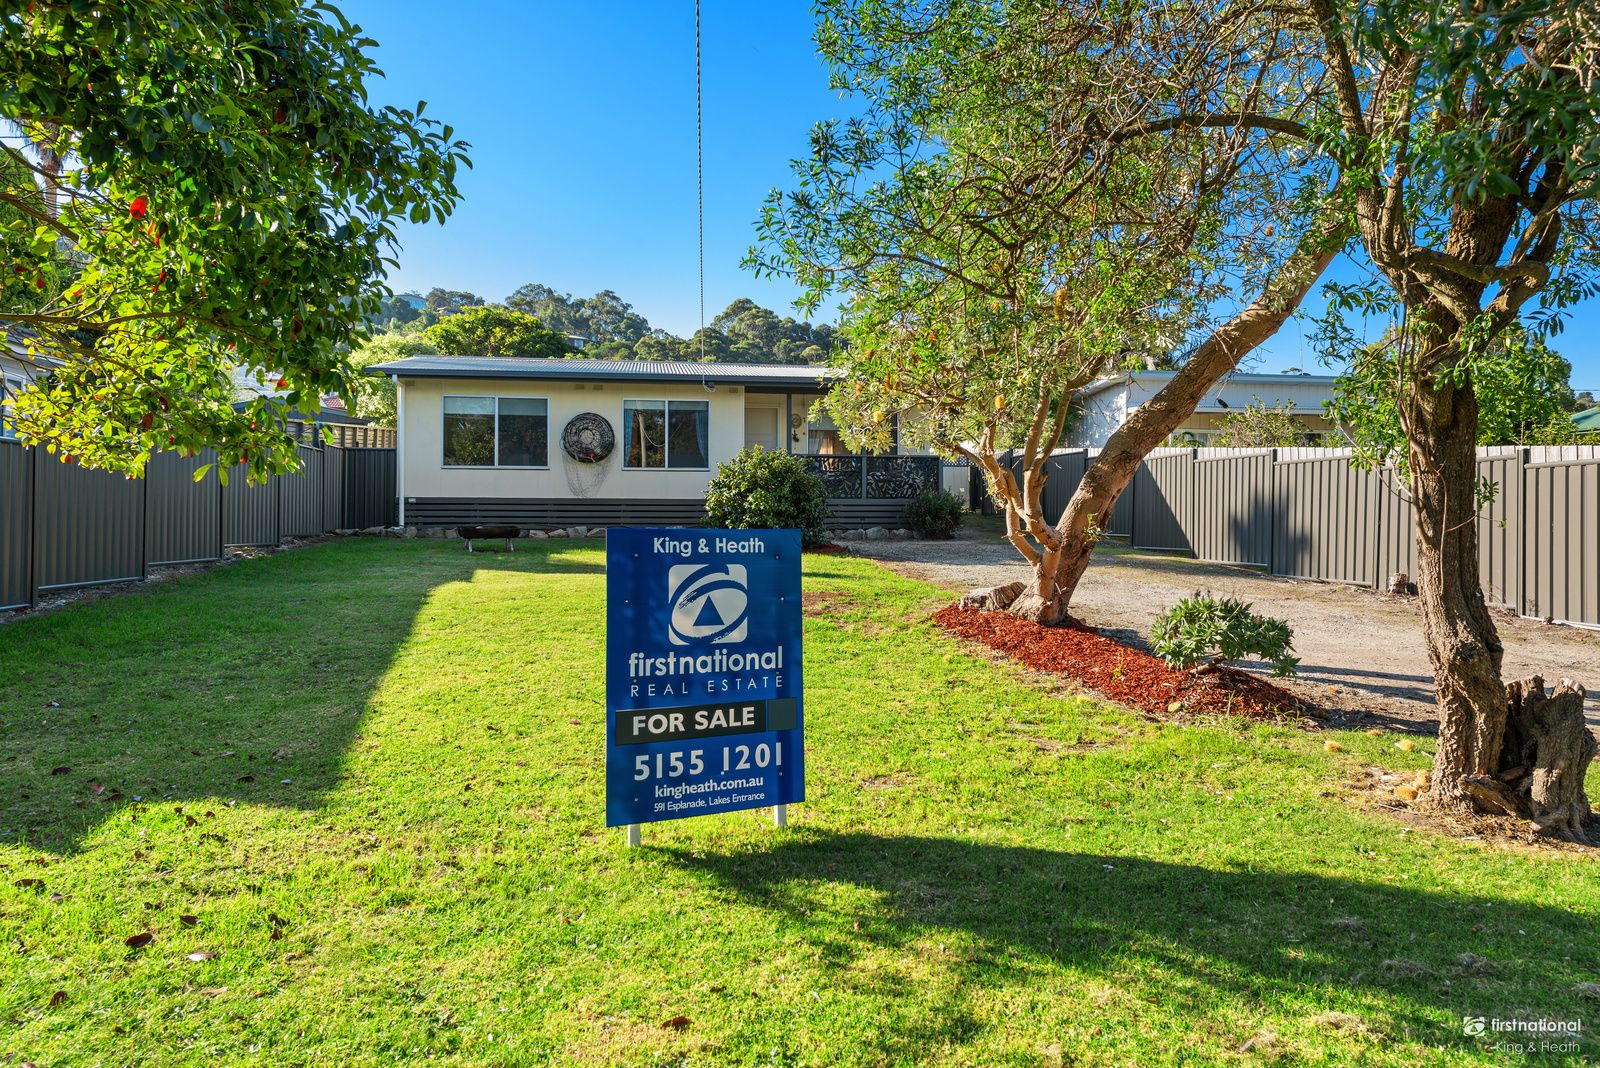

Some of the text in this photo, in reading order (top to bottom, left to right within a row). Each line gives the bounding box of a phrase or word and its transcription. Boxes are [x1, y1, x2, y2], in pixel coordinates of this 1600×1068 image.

[653, 537, 765, 557] King & Heath
[631, 675, 783, 697] REAL ESTATE
[633, 707, 755, 736] FOR SALE
[634, 742, 782, 781] 5155 1201
[655, 777, 764, 799] kingheath.com.au
[654, 792, 765, 813] 591 Esplanade, Lakes Entrance
